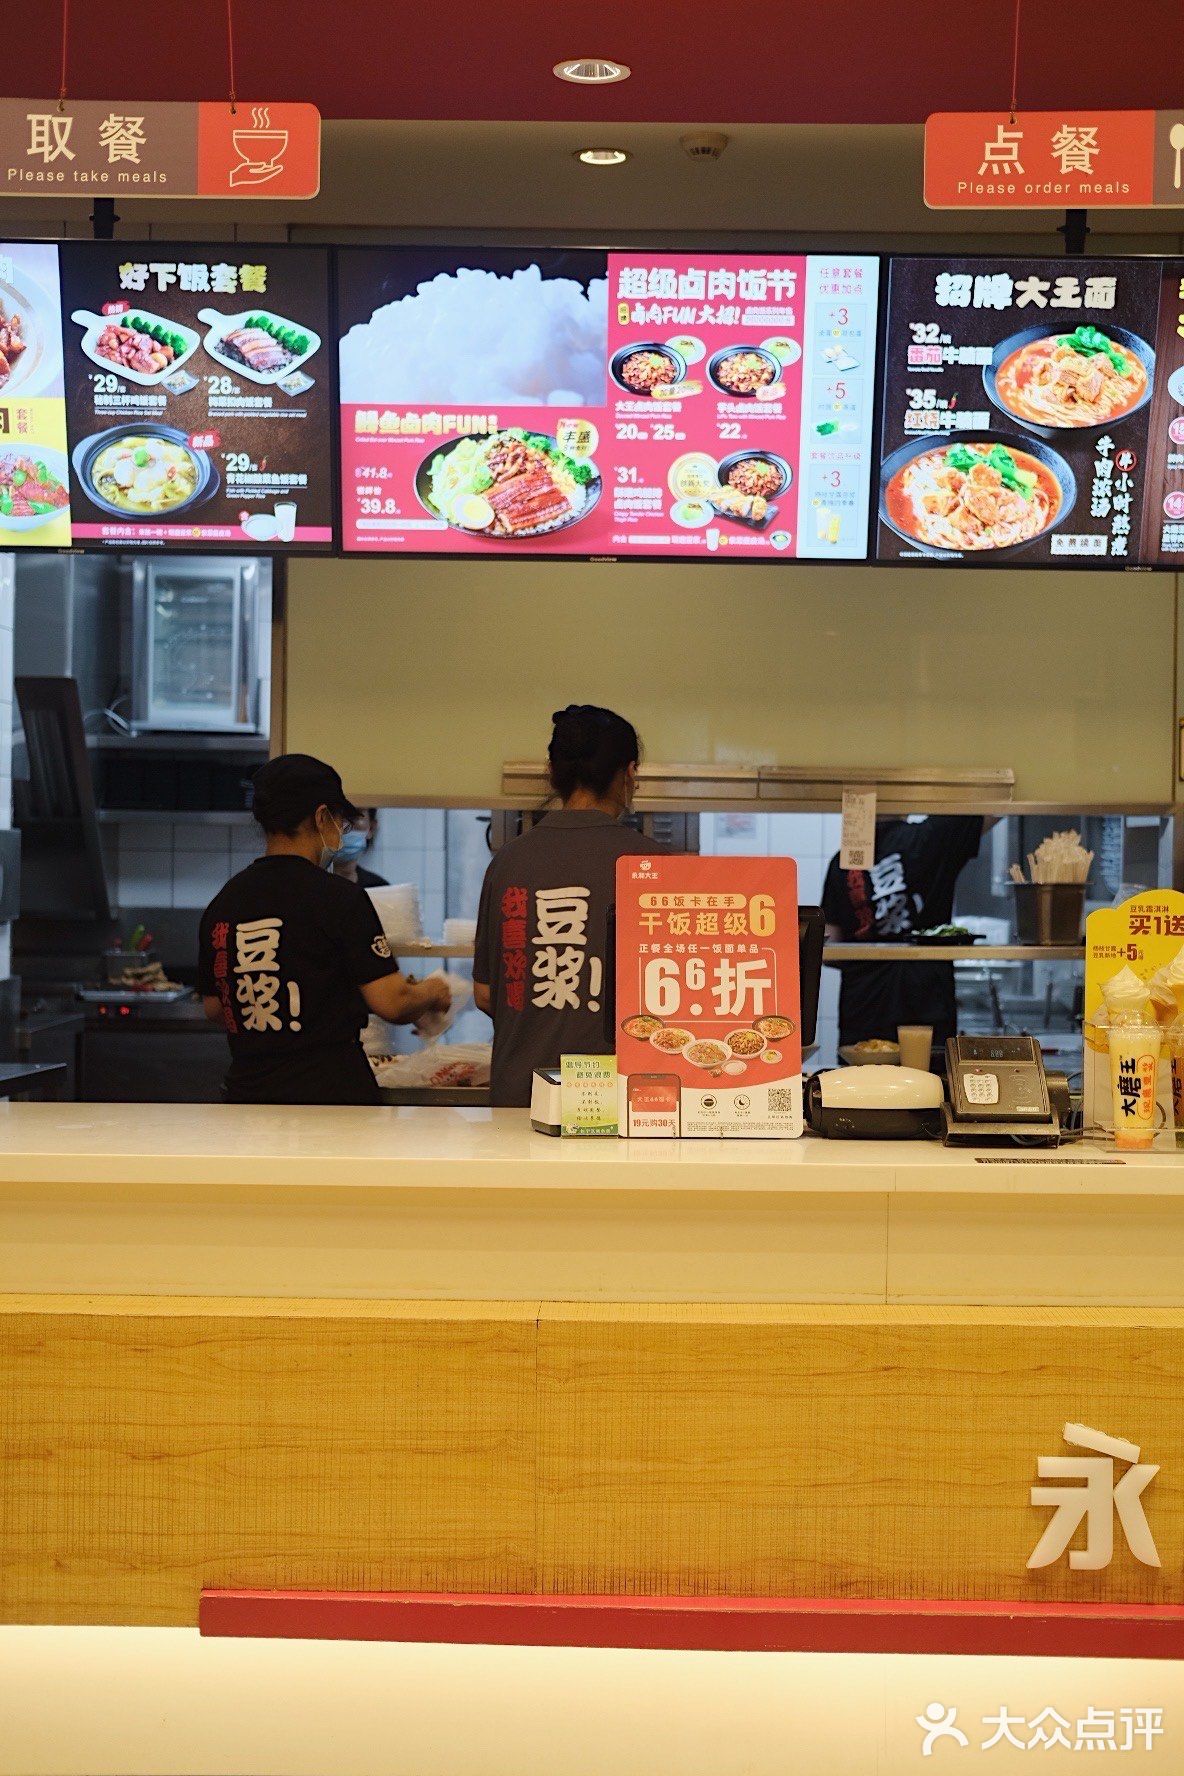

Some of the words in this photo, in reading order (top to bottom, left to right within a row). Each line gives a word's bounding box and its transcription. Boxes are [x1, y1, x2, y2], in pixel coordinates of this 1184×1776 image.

[26, 113, 148, 164] 取餐
[978, 124, 1100, 176] 点餐
[8, 168, 65, 182] Please
[73, 169, 109, 183] take
[118, 169, 167, 183] meals
[957, 182, 1016, 194] Please
[1025, 182, 1071, 193] order
[1079, 181, 1130, 193] meals
[617, 267, 797, 301] 超级卤肉饭节
[935, 272, 1117, 310] 招牌大王面
[638, 893, 776, 937] 干饭超级6
[650, 896, 736, 907] 66饭卡在手
[1130, 904, 1169, 913] 豆乳霜淇淋
[531, 886, 602, 1013] 豆浆!
[638, 943, 759, 954] 正餐全场任一饭面单品
[233, 917, 302, 1032] 豆浆!
[1117, 1057, 1141, 1117] 大磨王
[633, 1118, 676, 1127] 19元购30天
[1026, 1422, 1162, 1570] 永
